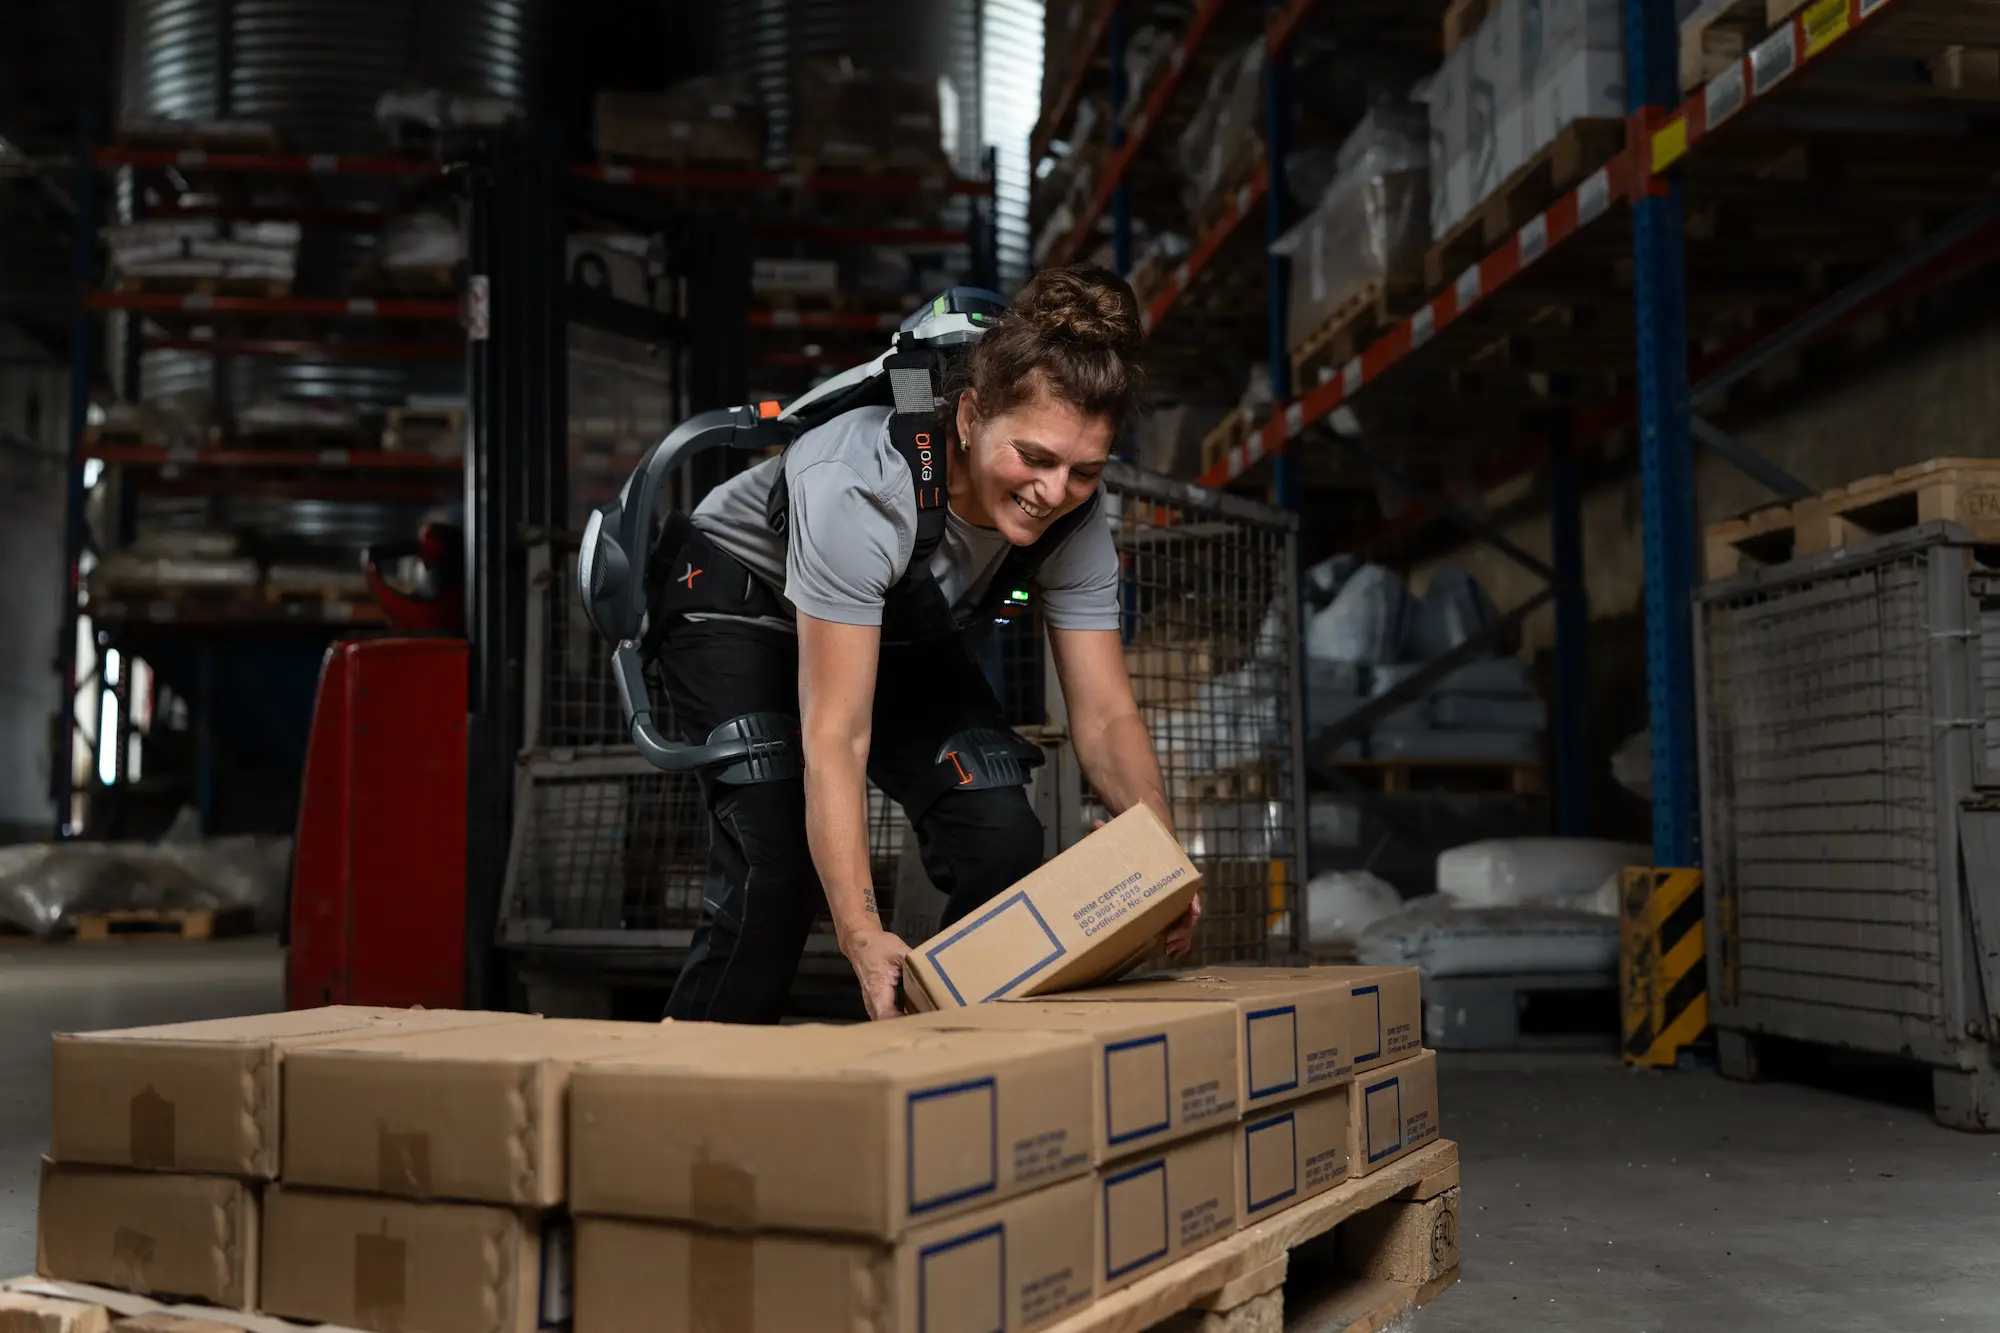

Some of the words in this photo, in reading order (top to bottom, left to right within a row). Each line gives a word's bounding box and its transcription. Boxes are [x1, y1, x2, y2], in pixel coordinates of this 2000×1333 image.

[1073, 901, 1098, 920] SIRIM
[1098, 872, 1141, 903] CERTIFIED
[1079, 916, 1096, 929] ISO
[1095, 902, 1116, 919] 9001
[1120, 885, 1141, 902] 2015
[1085, 907, 1127, 936] Certificate
[1143, 867, 1185, 898] QMS00491
